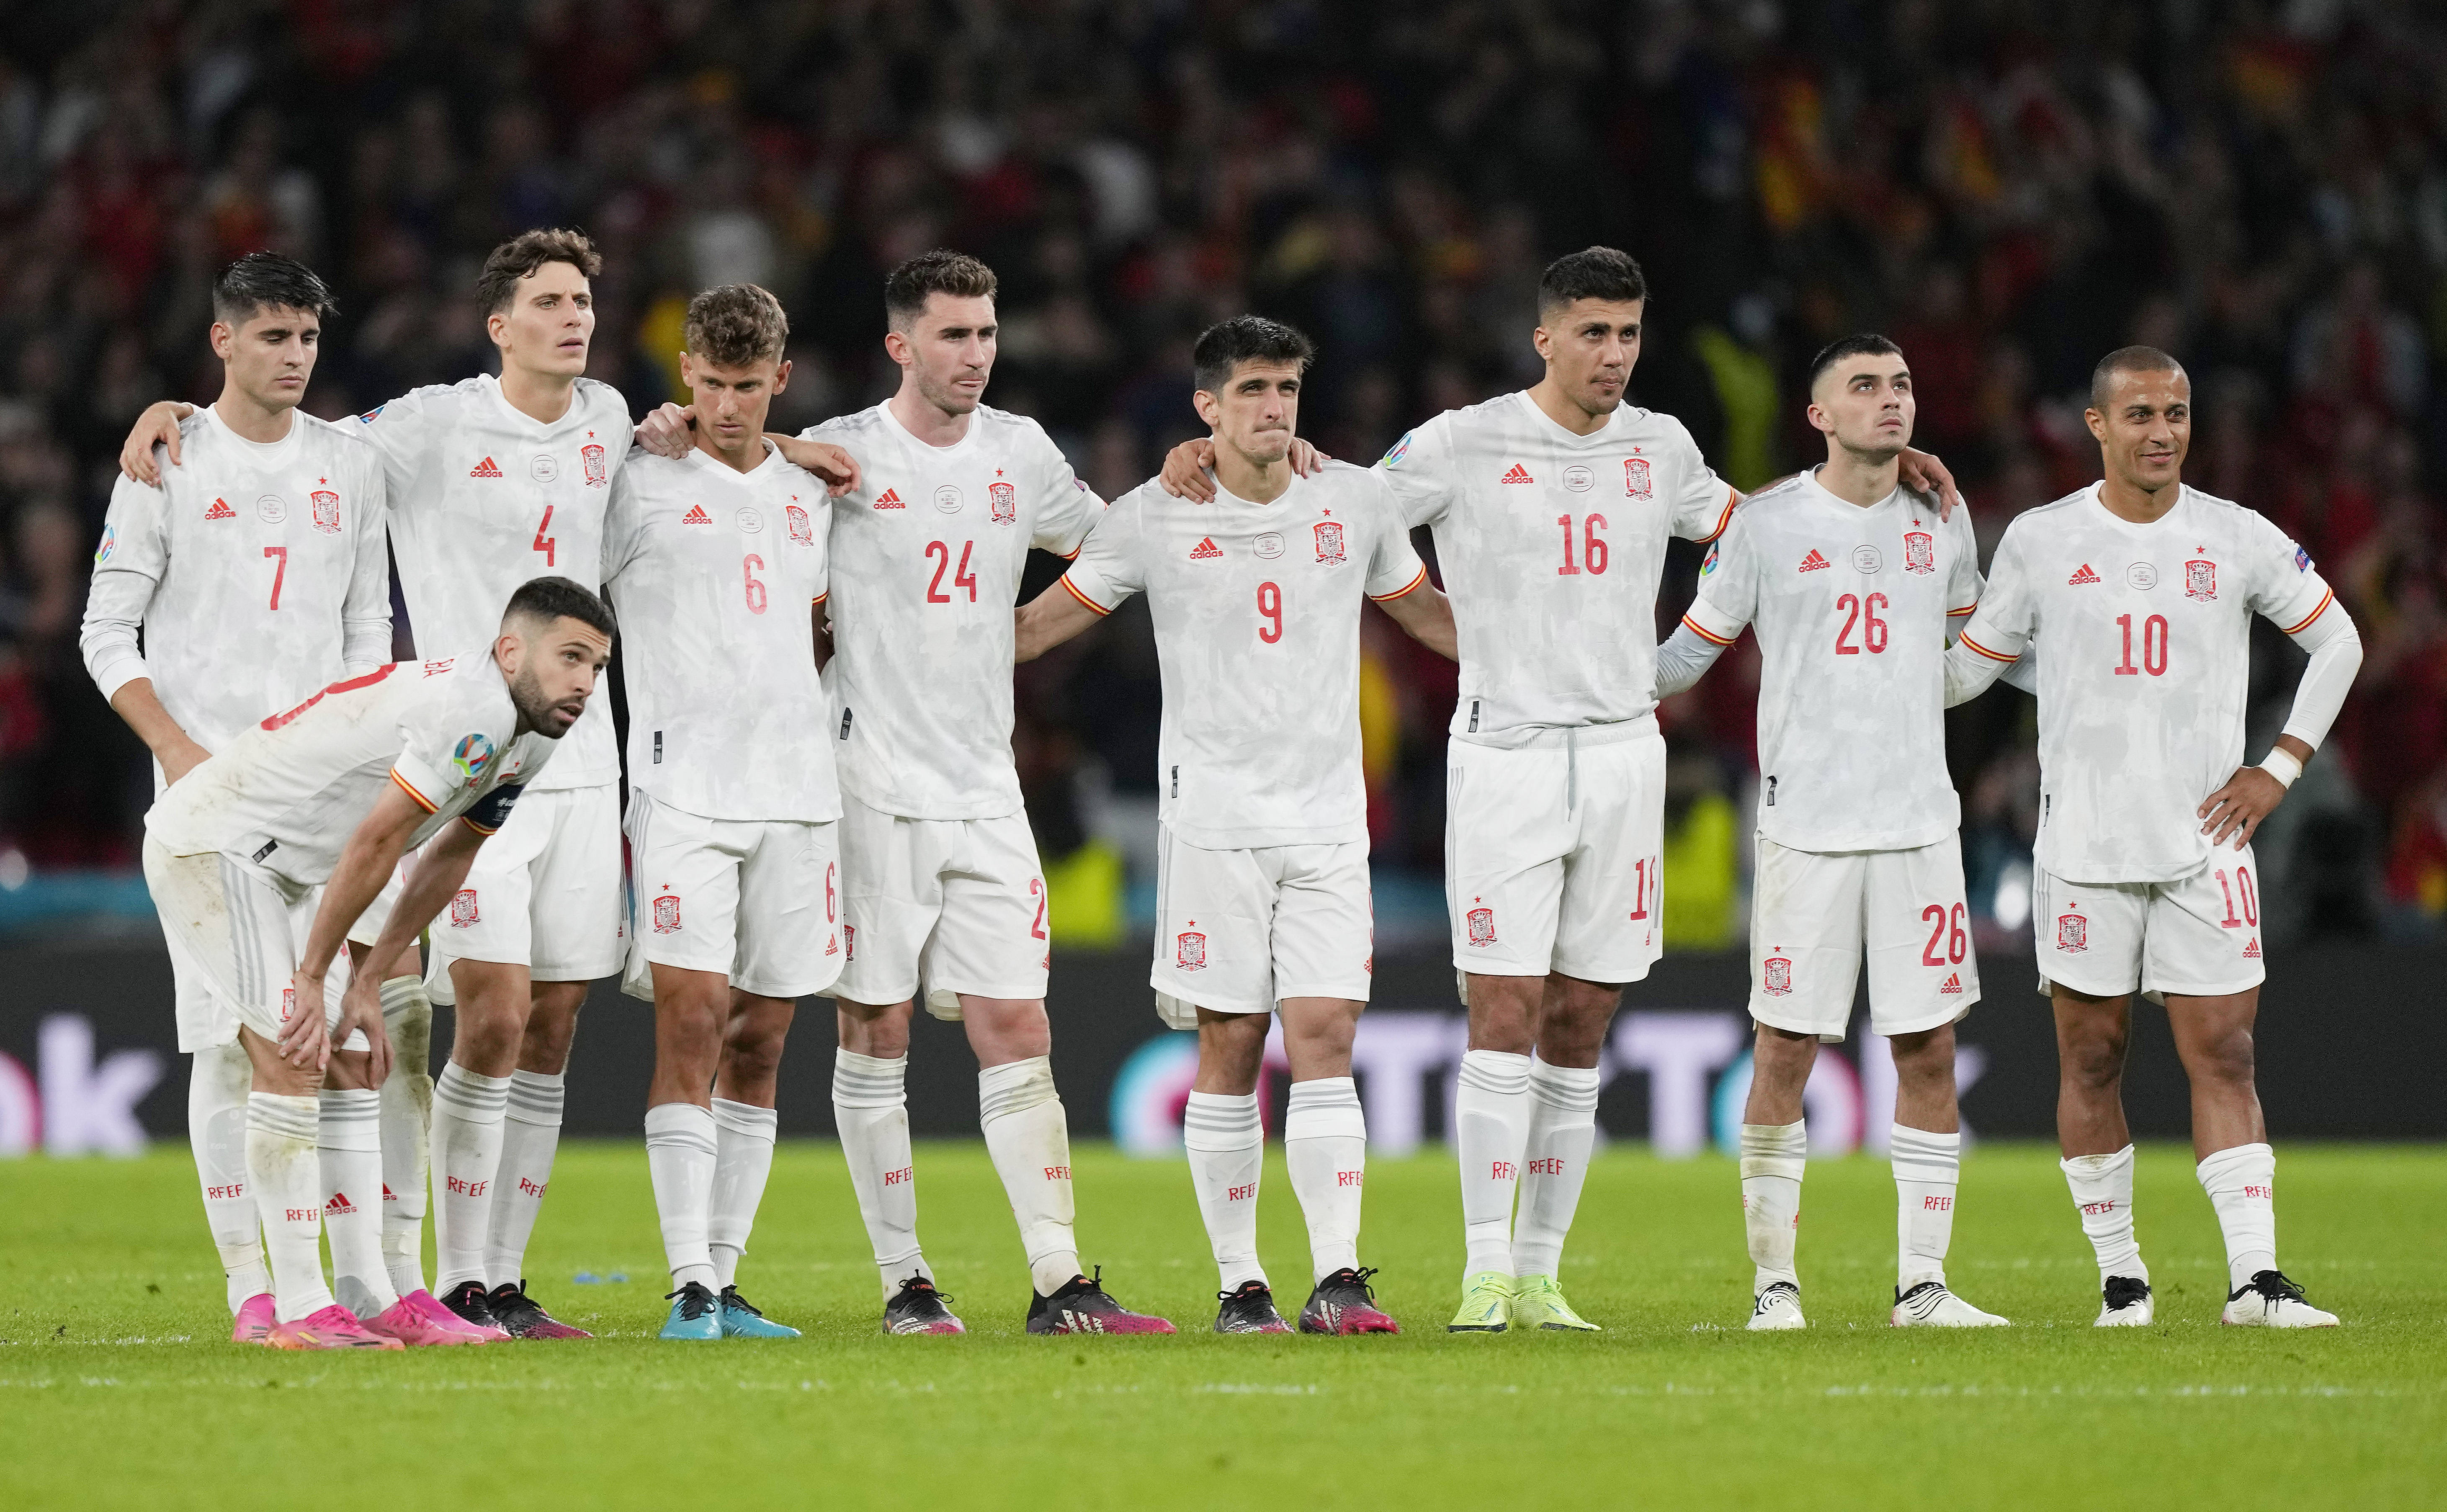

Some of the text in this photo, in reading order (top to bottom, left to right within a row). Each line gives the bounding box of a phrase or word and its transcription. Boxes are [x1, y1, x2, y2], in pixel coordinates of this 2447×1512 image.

[470, 469, 503, 478] adidas
[1501, 476, 1534, 484] adidas
[873, 501, 906, 509] adidas
[204, 510, 236, 520] adidas
[533, 506, 555, 567] 4
[1558, 513, 1608, 575] 16
[1189, 549, 1224, 559] adidas
[925, 540, 976, 603] 24
[1798, 561, 1831, 573] adidas
[264, 547, 287, 610] 7
[743, 554, 768, 614] 6
[2068, 575, 2101, 586] adidas
[1257, 581, 1282, 644] 9
[1836, 593, 1888, 655] 26
[2115, 614, 2168, 676] 10
[423, 659, 455, 679] BA
[2215, 866, 2257, 928] 10
[1030, 878, 1050, 940] 2
[1922, 902, 1966, 967] 26
[1529, 1158, 1565, 1175] RFEF
[208, 1184, 243, 1199] RFEF
[448, 1176, 488, 1197] RFEF
[1228, 1183, 1255, 1201] RFEF
[2244, 1186, 2272, 1198] RFEF
[1924, 1196, 1952, 1211] RFEF
[2084, 1200, 2114, 1215] RFEF
[286, 1209, 317, 1221] RFEF
